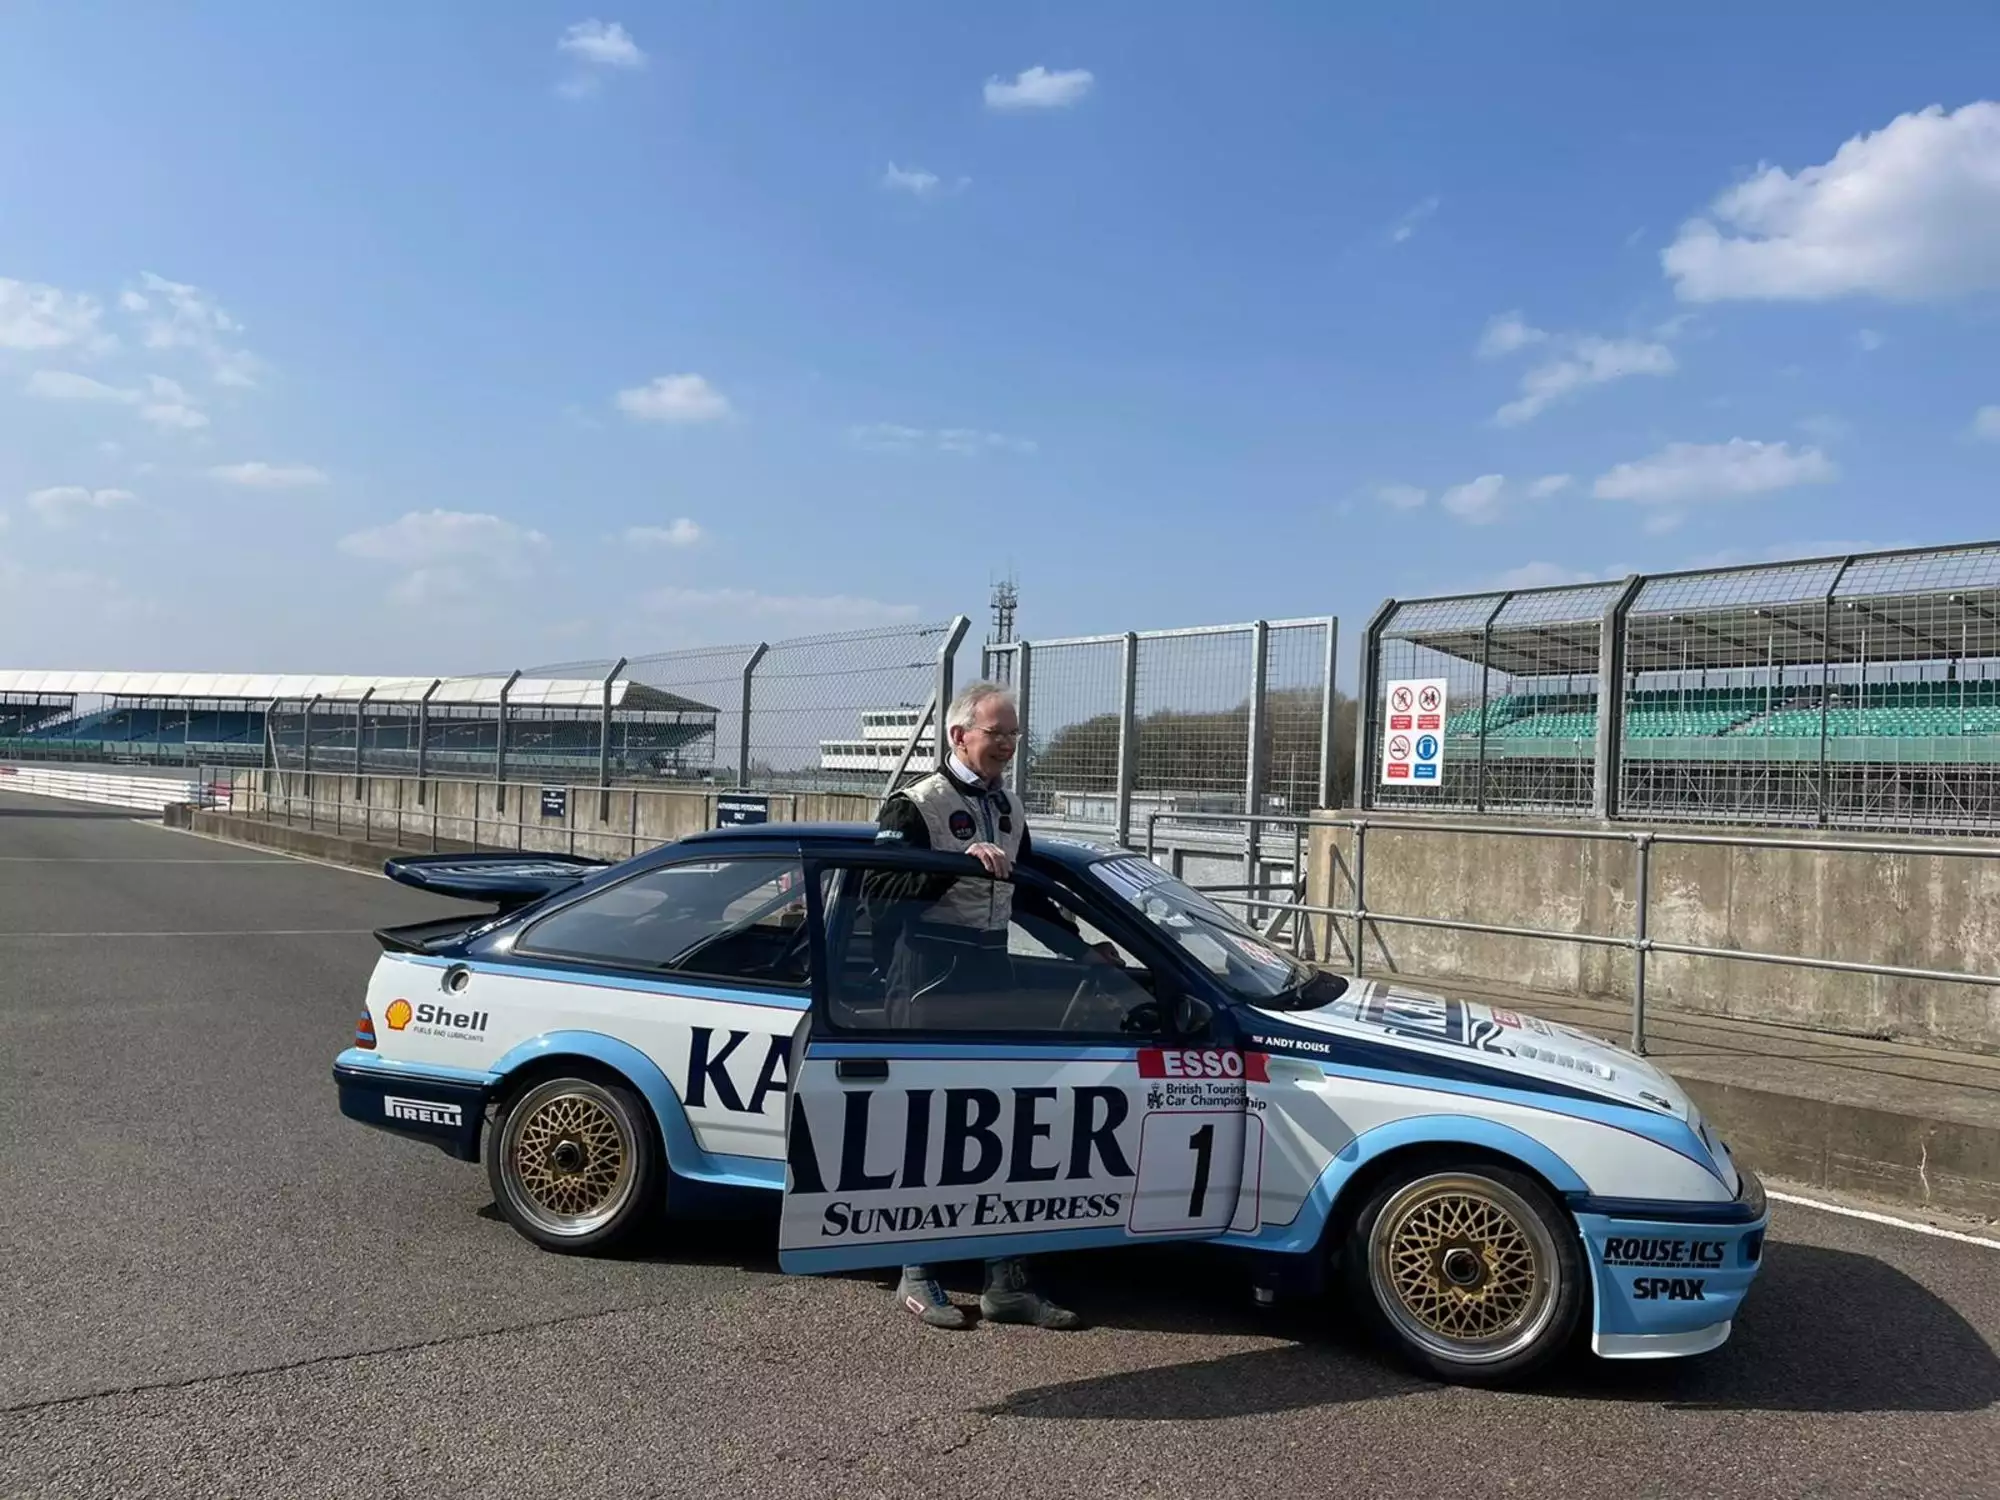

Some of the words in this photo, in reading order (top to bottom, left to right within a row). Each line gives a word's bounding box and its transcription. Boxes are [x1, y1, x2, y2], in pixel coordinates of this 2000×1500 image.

[416, 1003, 488, 1031] Shell
[1265, 1036, 1295, 1048] ANDY
[1296, 1040, 1331, 1054] ROUSE
[1162, 1051, 1245, 1078] ESSO
[1166, 1083, 1202, 1094] British
[1206, 1082, 1246, 1096] Touring
[1166, 1095, 1186, 1106] Car
[1191, 1094, 1267, 1111] Championhip
[384, 1095, 462, 1126] PIRELLI
[1188, 1124, 1214, 1218] 1
[821, 1201, 969, 1237] SUNDAY
[970, 1192, 1122, 1226] EXPRESS
[1632, 1277, 1706, 1301] SPAX
